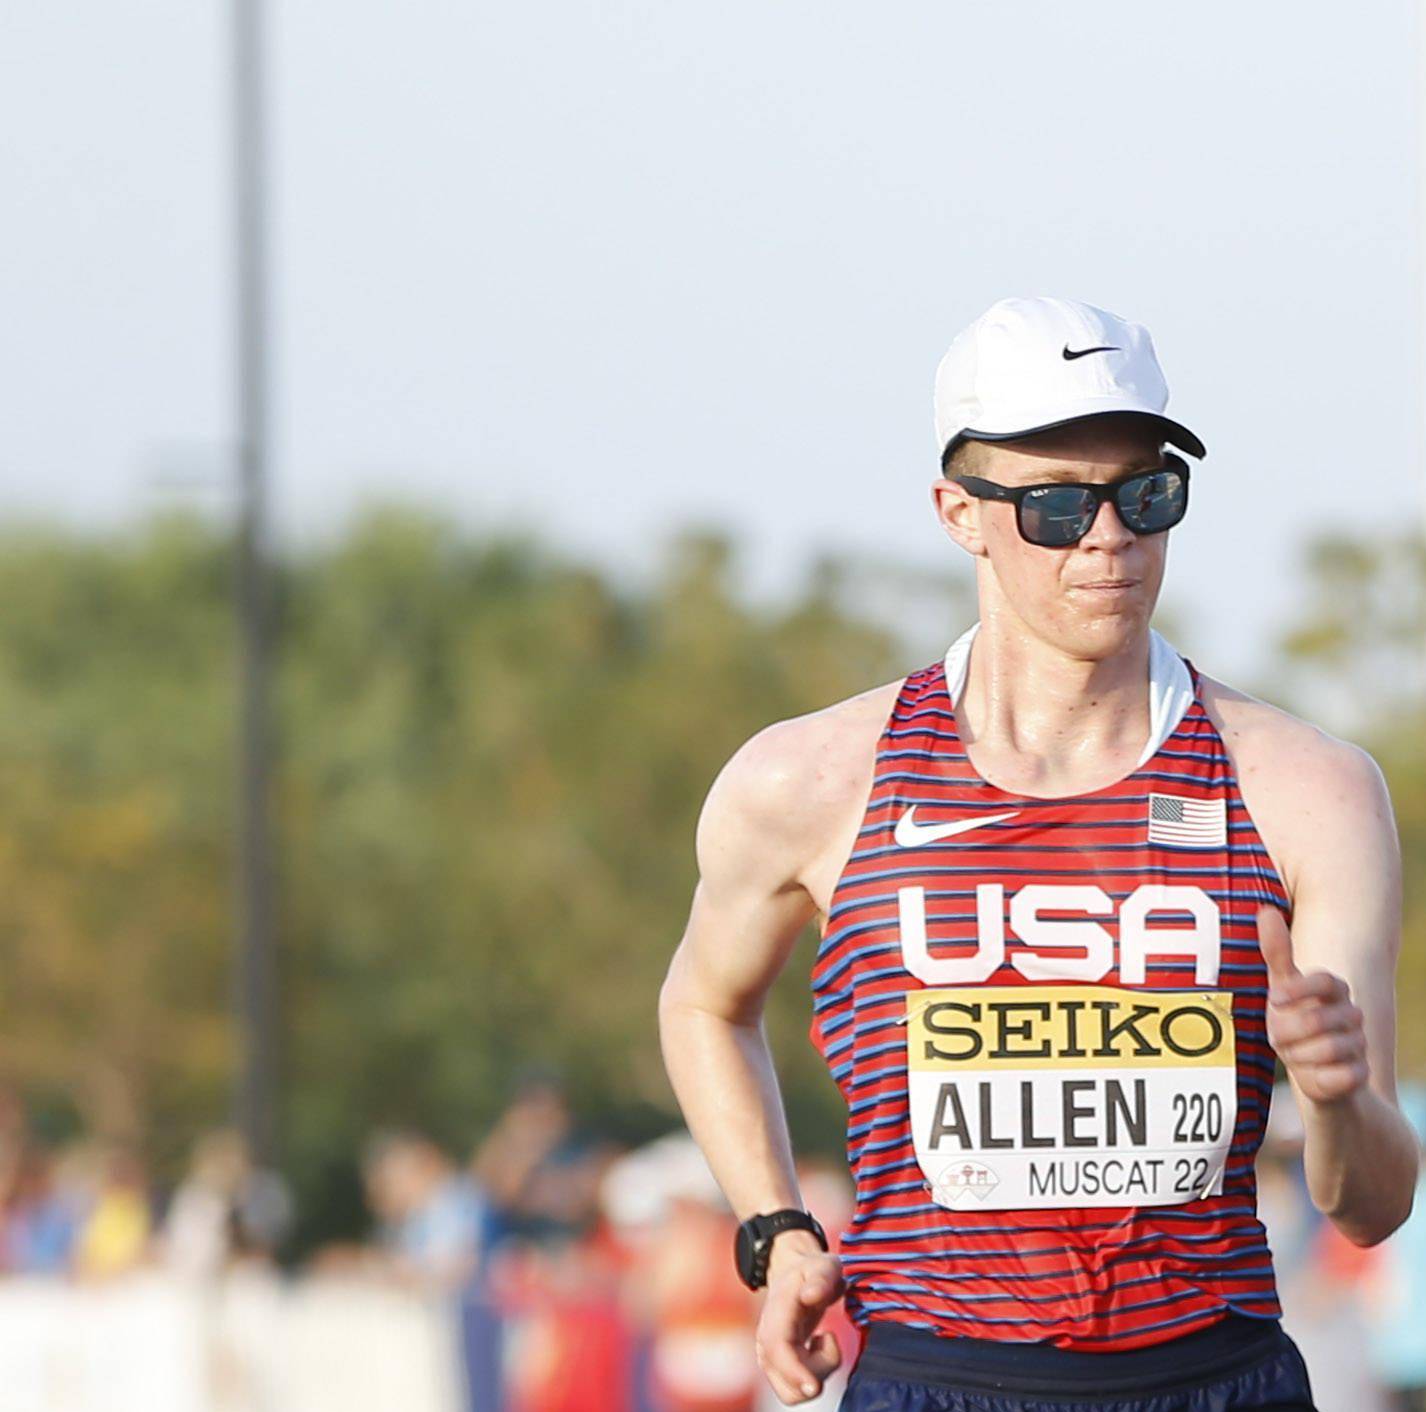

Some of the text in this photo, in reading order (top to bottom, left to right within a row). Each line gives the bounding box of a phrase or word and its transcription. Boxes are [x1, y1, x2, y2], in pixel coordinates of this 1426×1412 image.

[898, 883, 1221, 986] USA
[923, 1000, 1223, 1061] SEIKO
[928, 1079, 1222, 1151] ALLEN 220
[1029, 1158, 1209, 1197] MUSCAT 22
